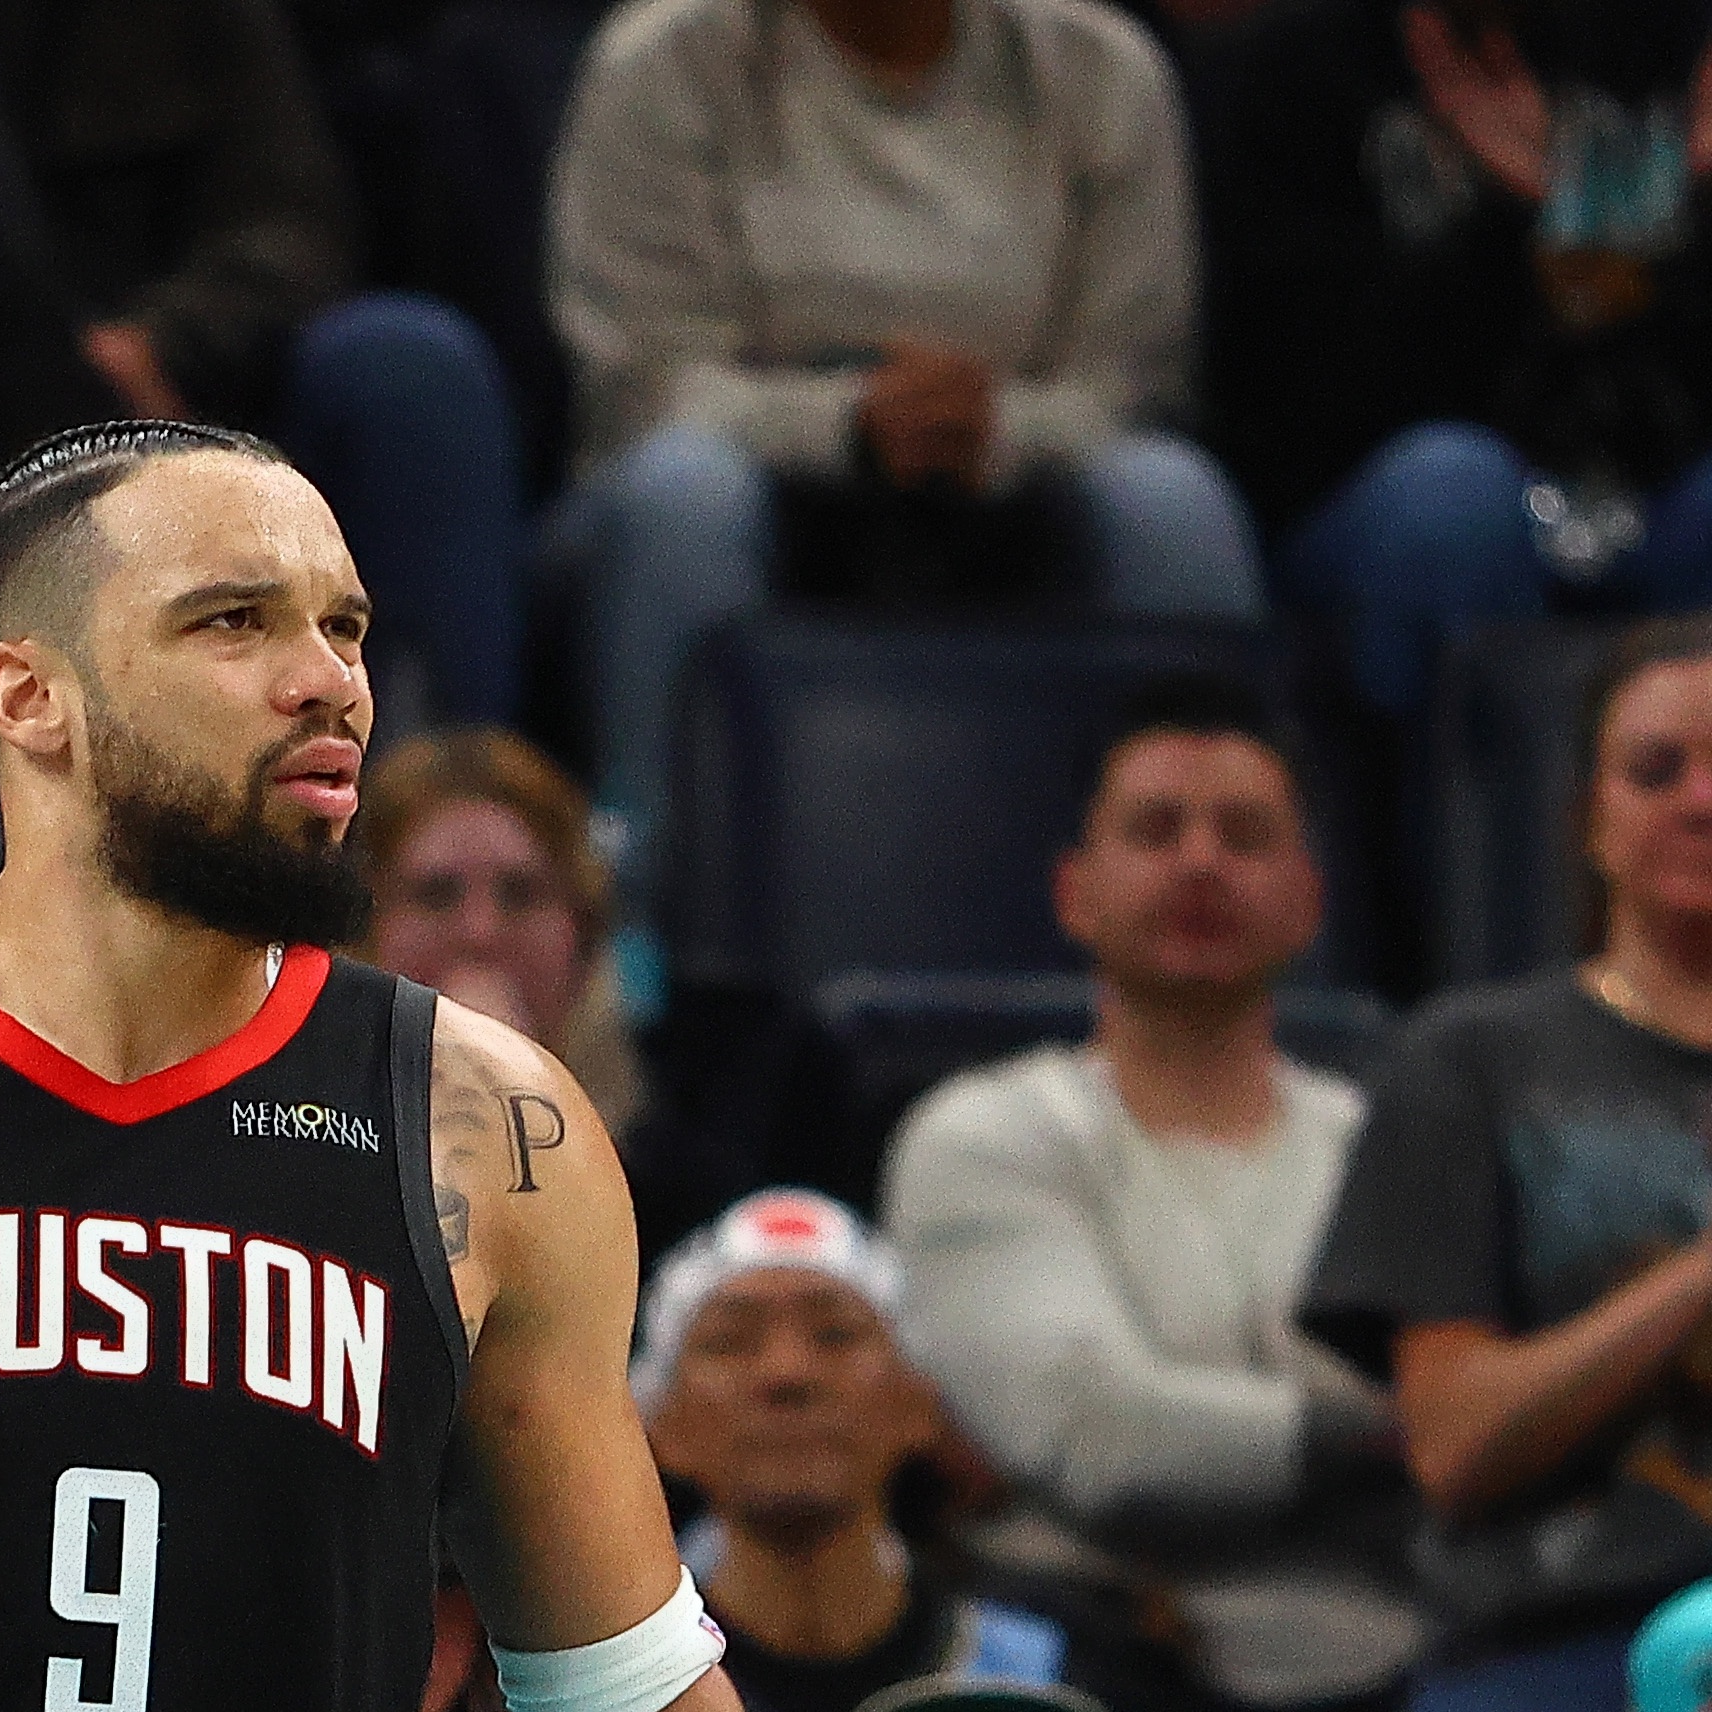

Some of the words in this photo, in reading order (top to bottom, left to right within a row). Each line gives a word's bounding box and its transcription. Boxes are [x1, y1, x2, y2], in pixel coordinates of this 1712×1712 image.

[231, 1100, 376, 1138] MEMORIAL
[232, 1117, 380, 1154] HERMANN
[489, 1085, 566, 1194] P
